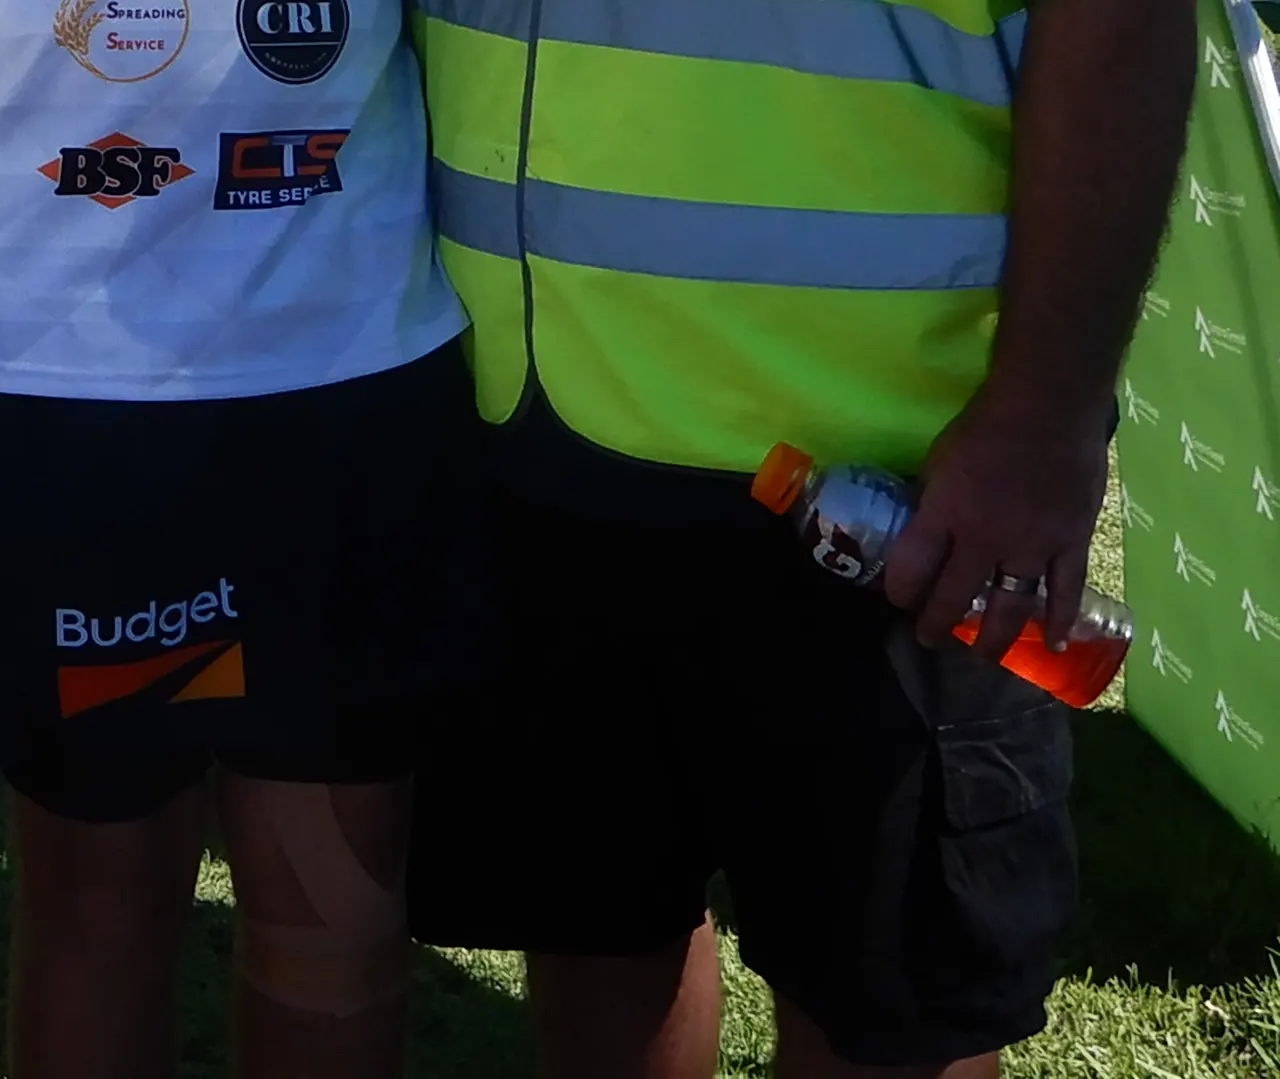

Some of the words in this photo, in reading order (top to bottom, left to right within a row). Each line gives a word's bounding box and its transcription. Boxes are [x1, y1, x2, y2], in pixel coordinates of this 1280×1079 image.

[256, 1, 334, 34] CRI
[53, 147, 181, 197] BSF
[232, 133, 350, 178] CTS
[227, 190, 273, 205] TYRE
[55, 577, 239, 646] Budget
